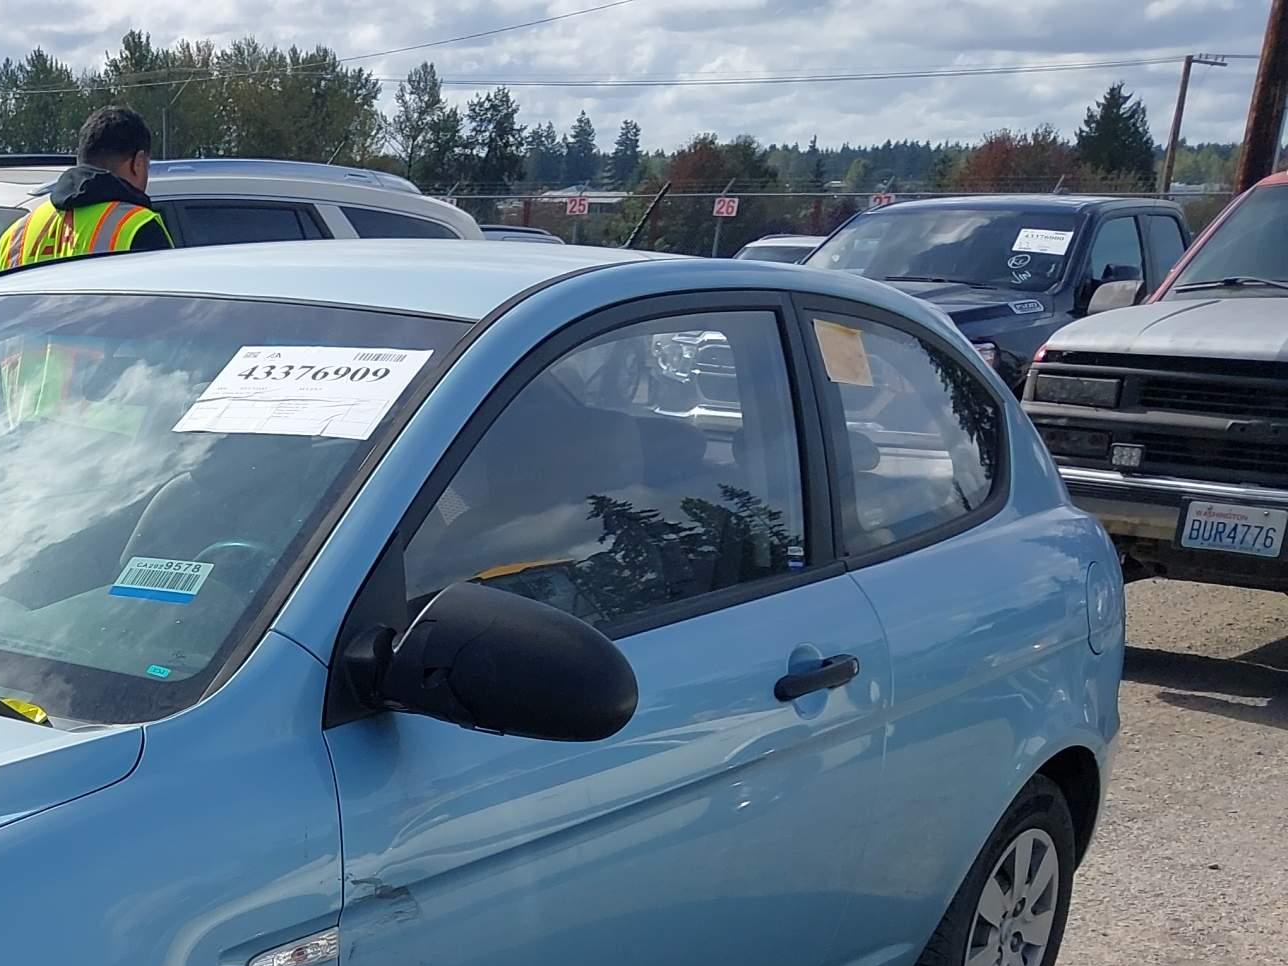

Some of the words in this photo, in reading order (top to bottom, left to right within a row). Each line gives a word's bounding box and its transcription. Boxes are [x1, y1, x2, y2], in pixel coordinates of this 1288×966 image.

[569, 200, 586, 213] 25
[715, 200, 735, 214] 26
[237, 364, 391, 382] 43376909
[1188, 518, 1276, 549] BUR4776
